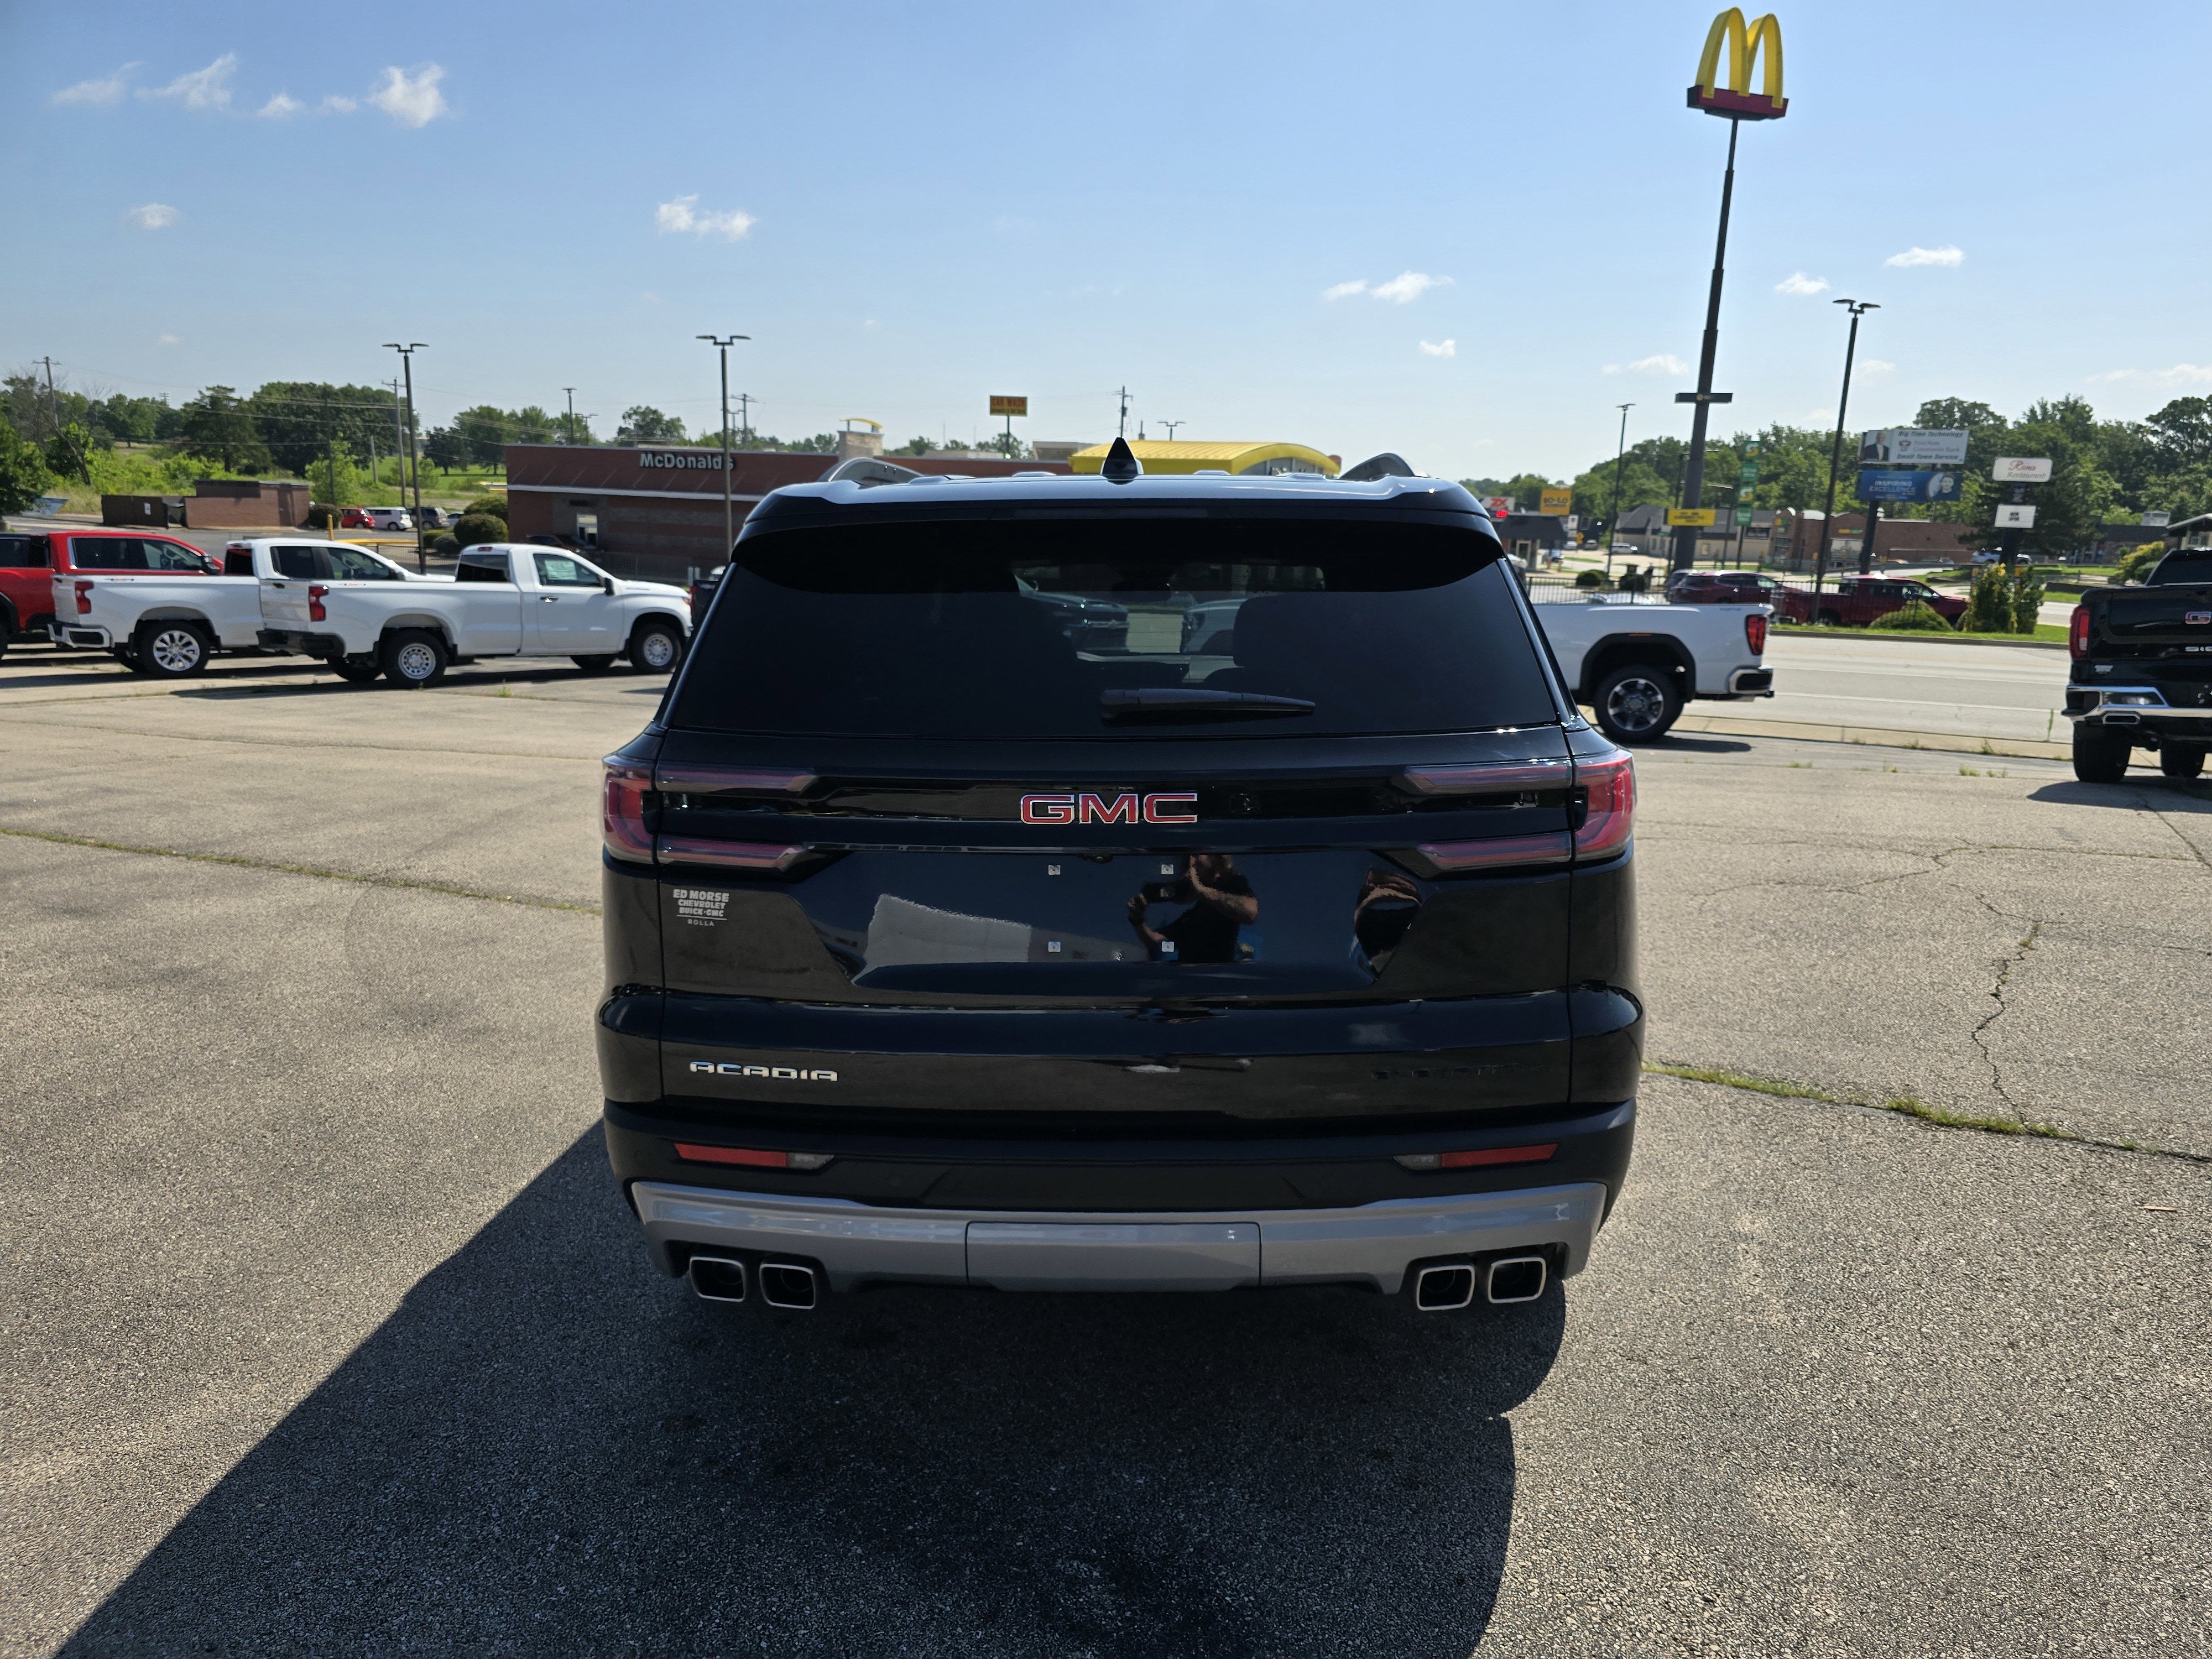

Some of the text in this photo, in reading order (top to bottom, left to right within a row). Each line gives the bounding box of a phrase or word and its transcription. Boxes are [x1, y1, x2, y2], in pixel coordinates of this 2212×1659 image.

[640, 453, 734, 469] McDonalds
[1020, 793, 1197, 825] GMC
[673, 889, 729, 902] ED MORSE
[677, 899, 726, 909] CHEVROLET
[690, 1061, 838, 1082] ACADIA
